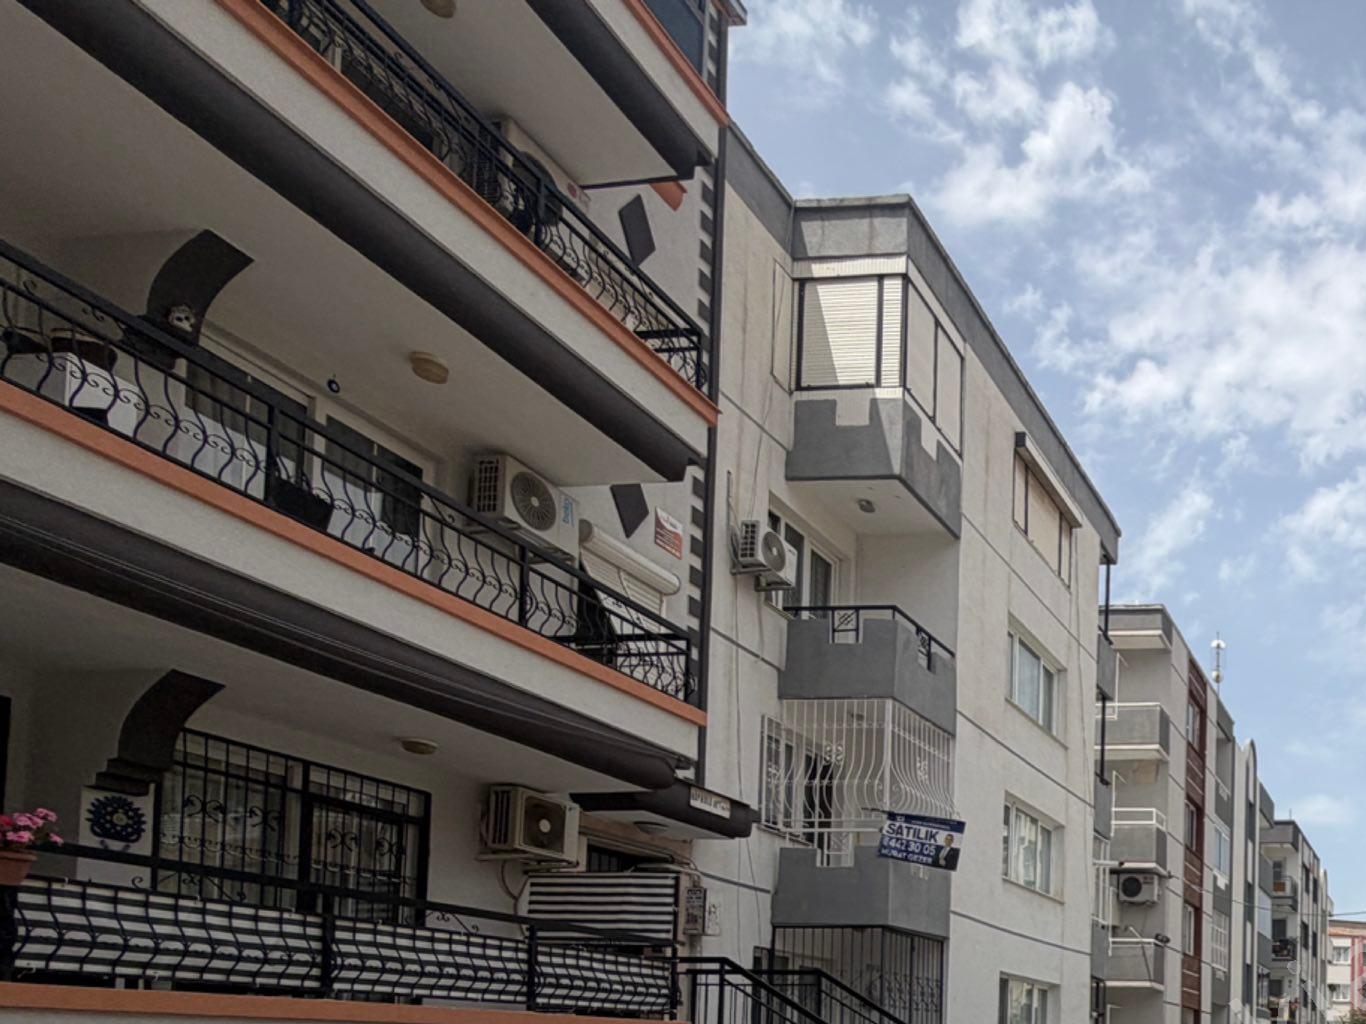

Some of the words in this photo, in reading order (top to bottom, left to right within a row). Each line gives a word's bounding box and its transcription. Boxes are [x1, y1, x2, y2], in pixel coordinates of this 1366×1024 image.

[886, 823, 939, 843] SATILIK
[908, 841, 921, 853] 30
[923, 844, 936, 856] 05
